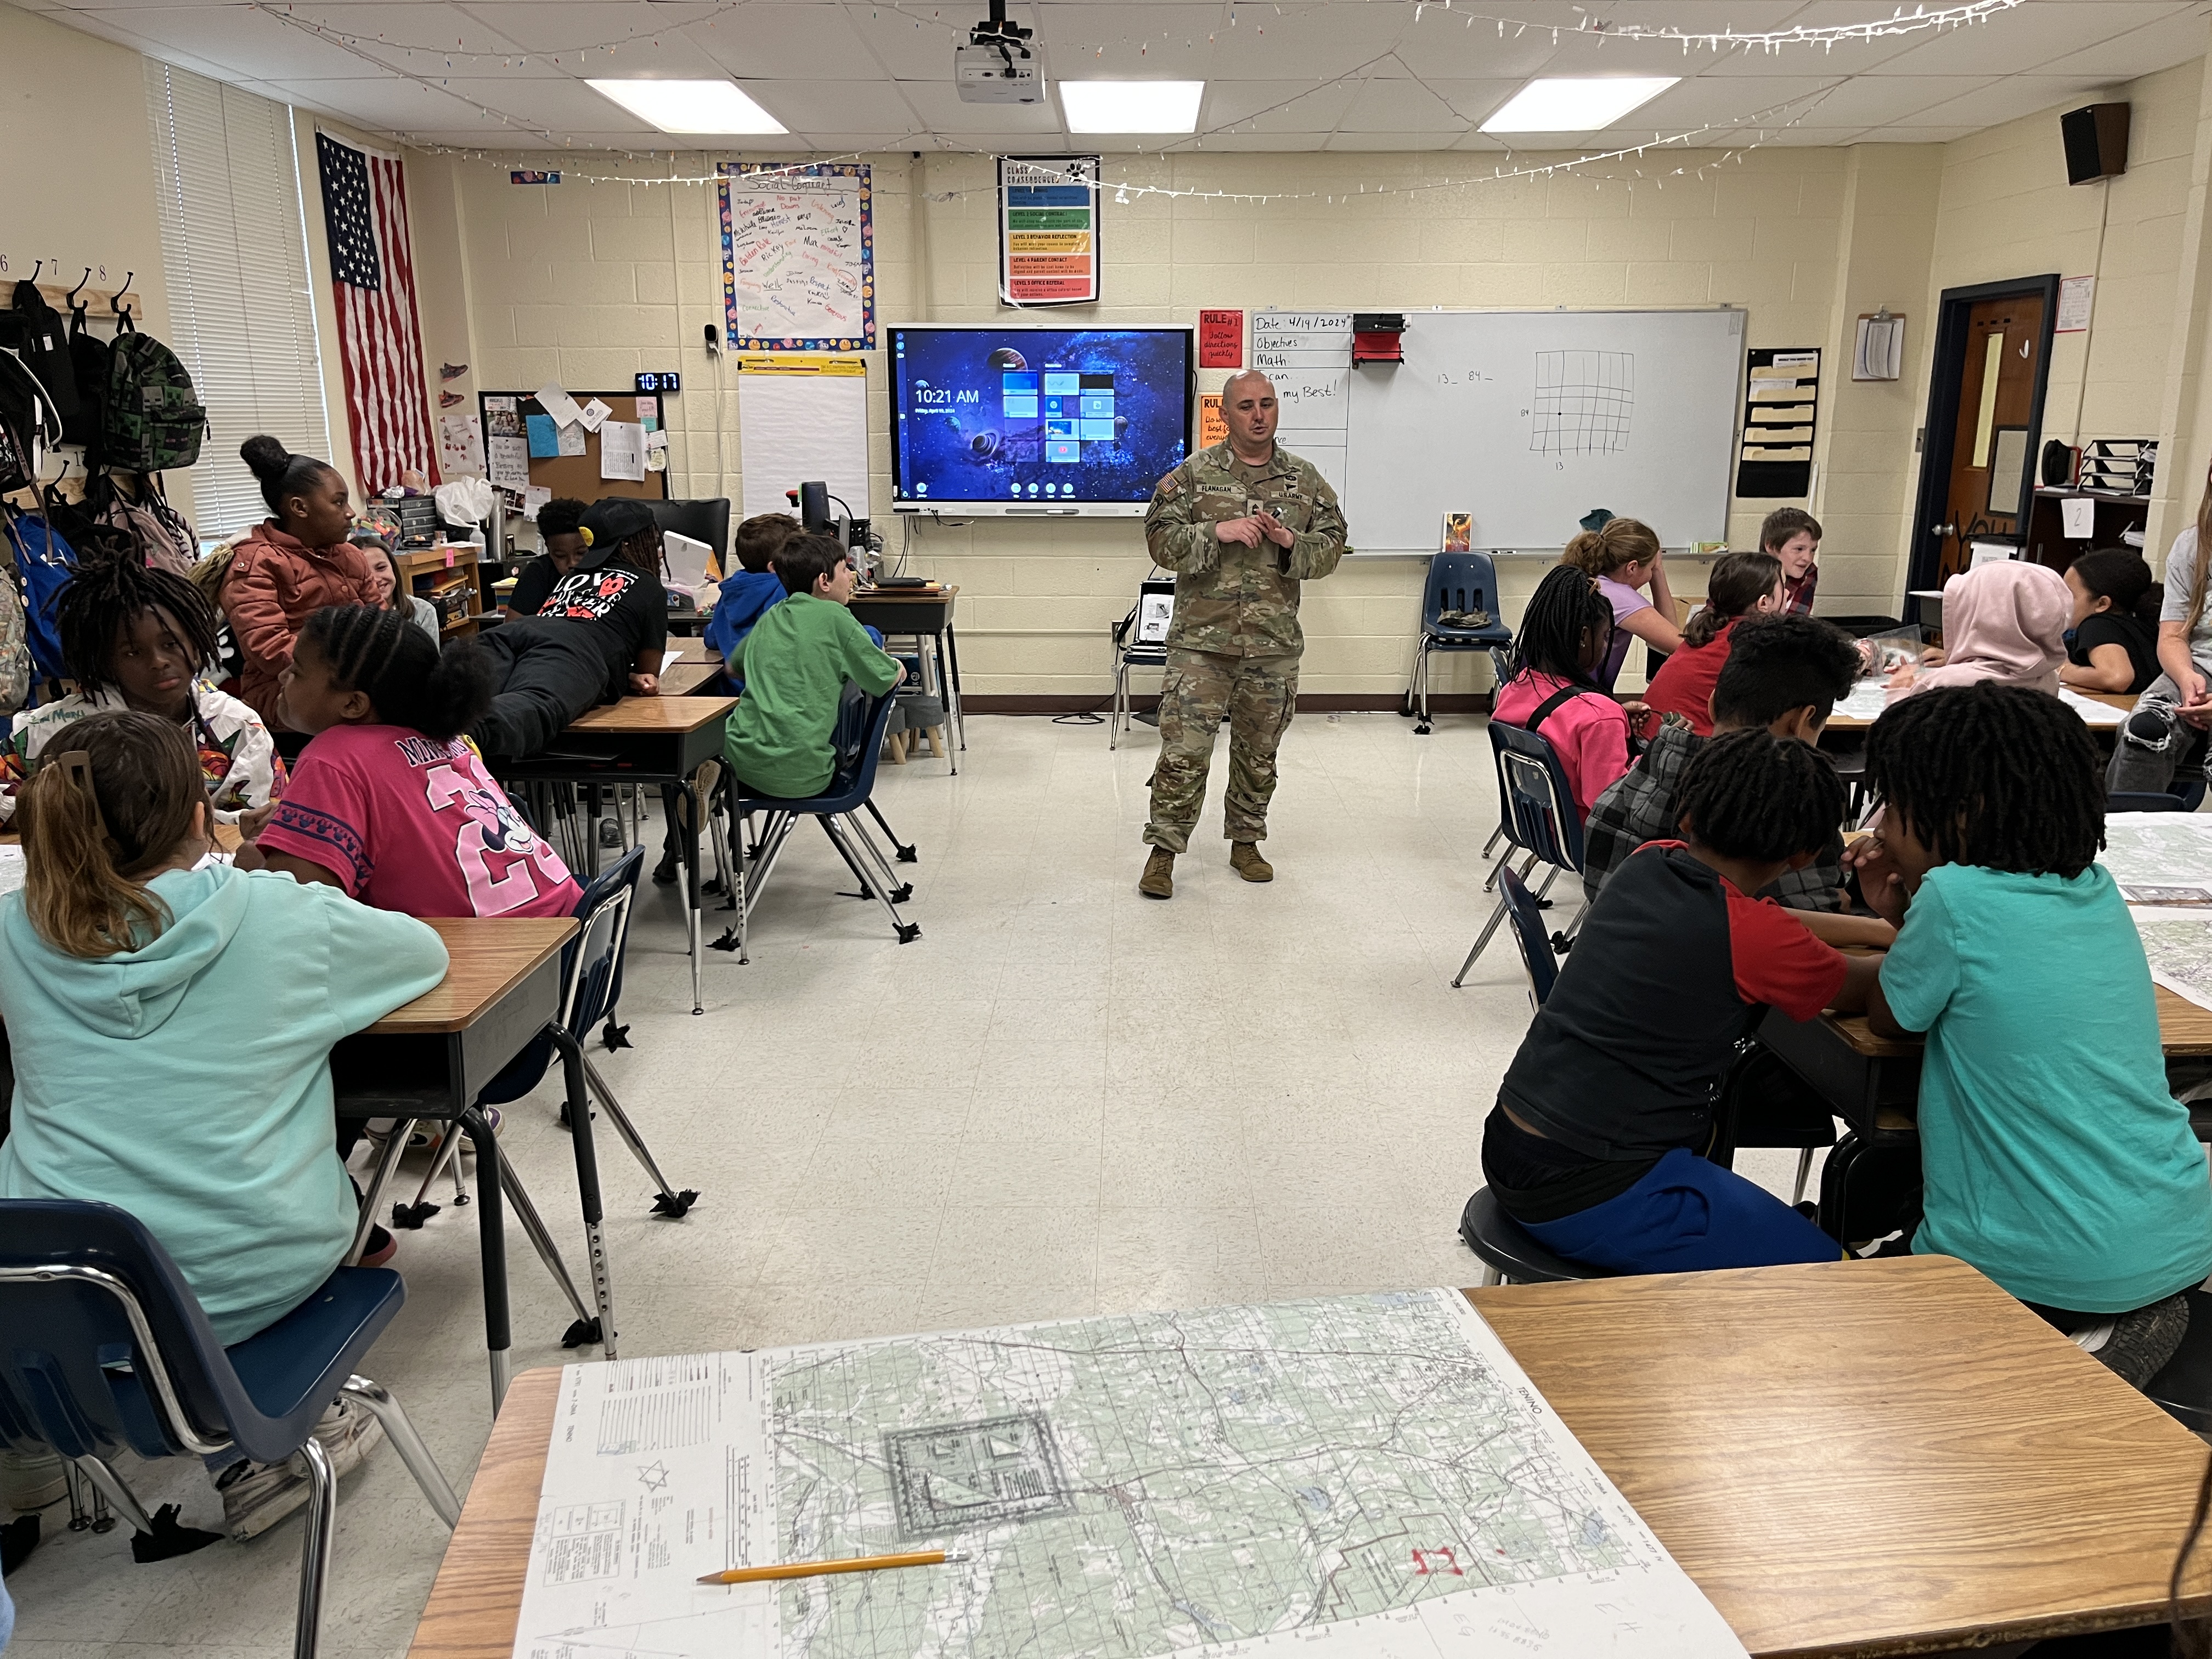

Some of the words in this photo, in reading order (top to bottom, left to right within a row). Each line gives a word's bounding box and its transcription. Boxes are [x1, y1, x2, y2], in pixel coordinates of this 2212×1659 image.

[747, 177, 786, 190] Social
[792, 176, 832, 190] Contract
[0, 254, 8, 272] 6
[739, 247, 759, 267] Golden
[51, 259, 58, 275] 7
[99, 265, 106, 281] 8
[1204, 314, 1227, 324] RULE
[1204, 341, 1238, 349] directions
[1257, 336, 1298, 351] Objectives
[1209, 349, 1233, 359] quickly
[638, 374, 677, 390] 10:17
[916, 390, 951, 404] 10:21
[956, 390, 979, 404] AM
[1283, 392, 1299, 404] my
[1303, 379, 1337, 398] Best!
[1521, 409, 1529, 417] 84
[1556, 462, 1564, 470] 13
[2074, 507, 2082, 527] 2
[1516, 1386, 1543, 1415] TENINO
